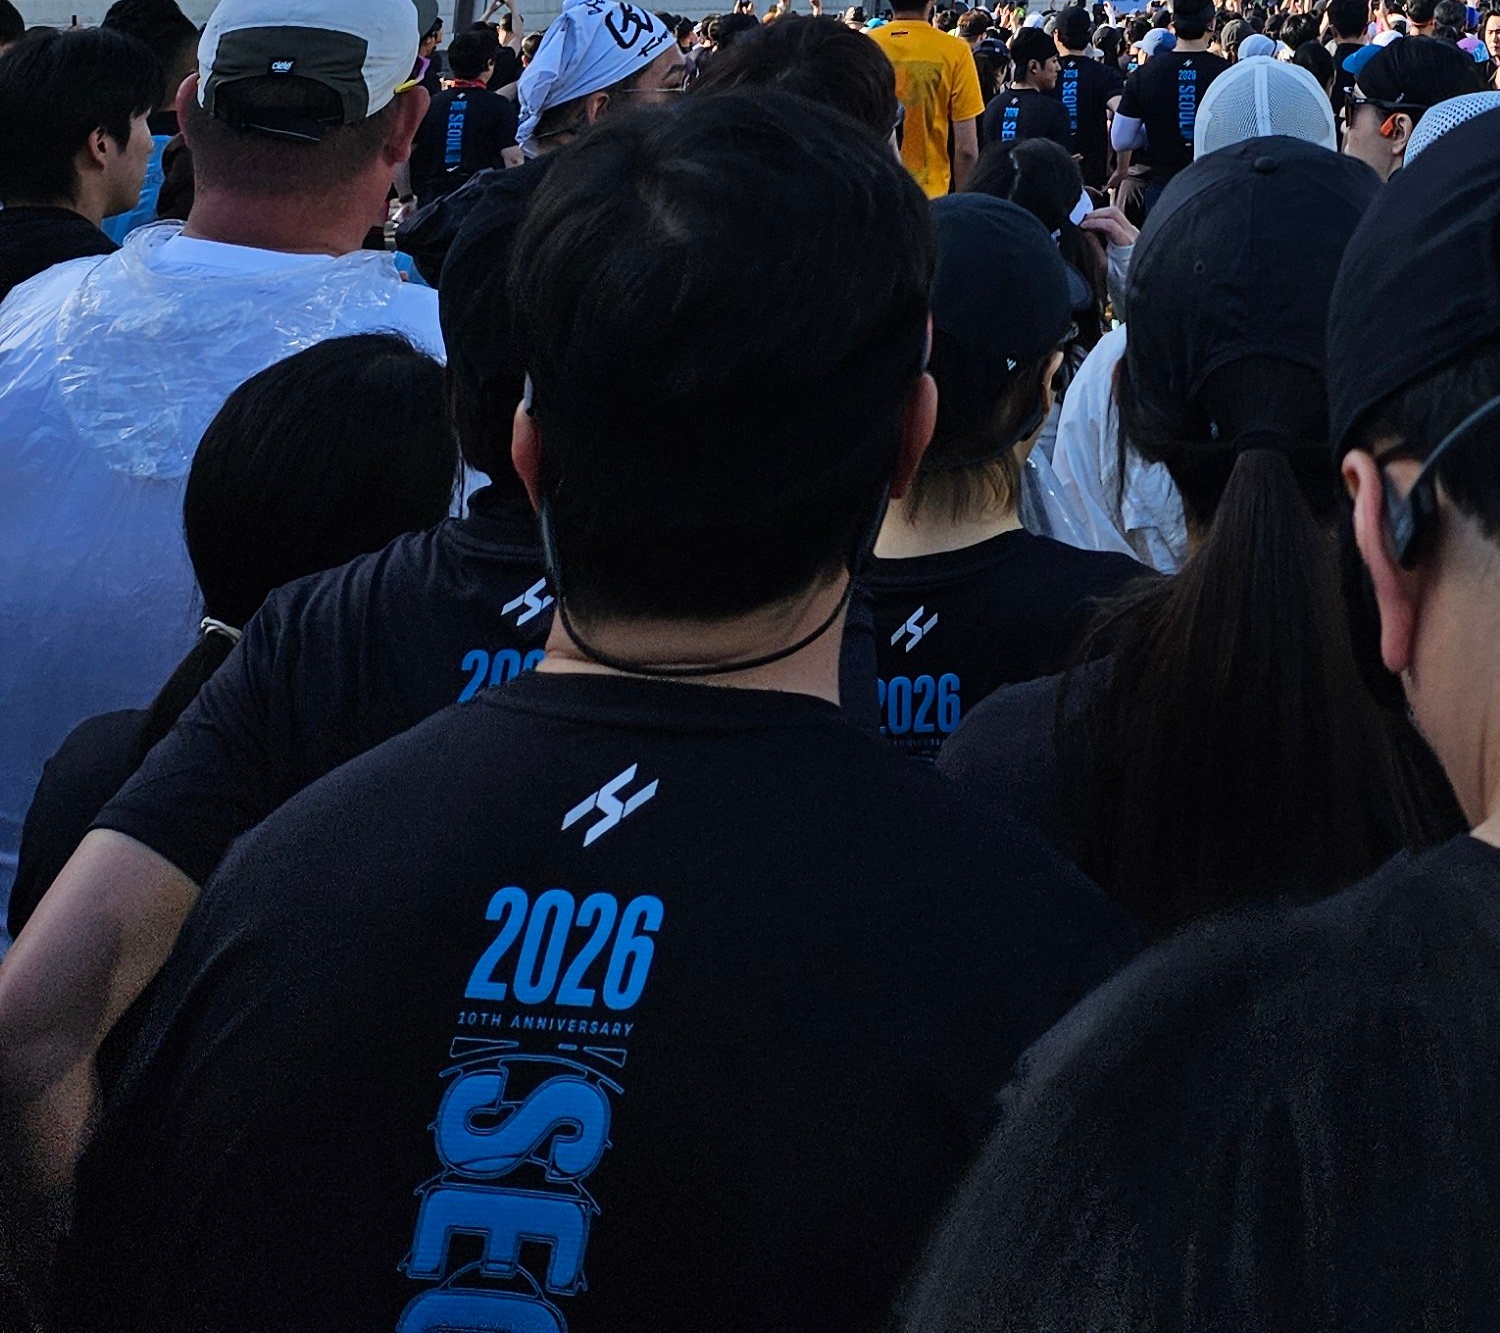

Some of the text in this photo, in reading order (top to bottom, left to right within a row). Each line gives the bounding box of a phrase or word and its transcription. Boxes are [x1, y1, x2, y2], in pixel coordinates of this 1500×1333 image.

[1178, 85, 1195, 135] SEOUL
[447, 114, 465, 156] SEOUL
[464, 886, 664, 1010] 2026
[457, 1011, 635, 1037] 10TH ANNIVERSARY
